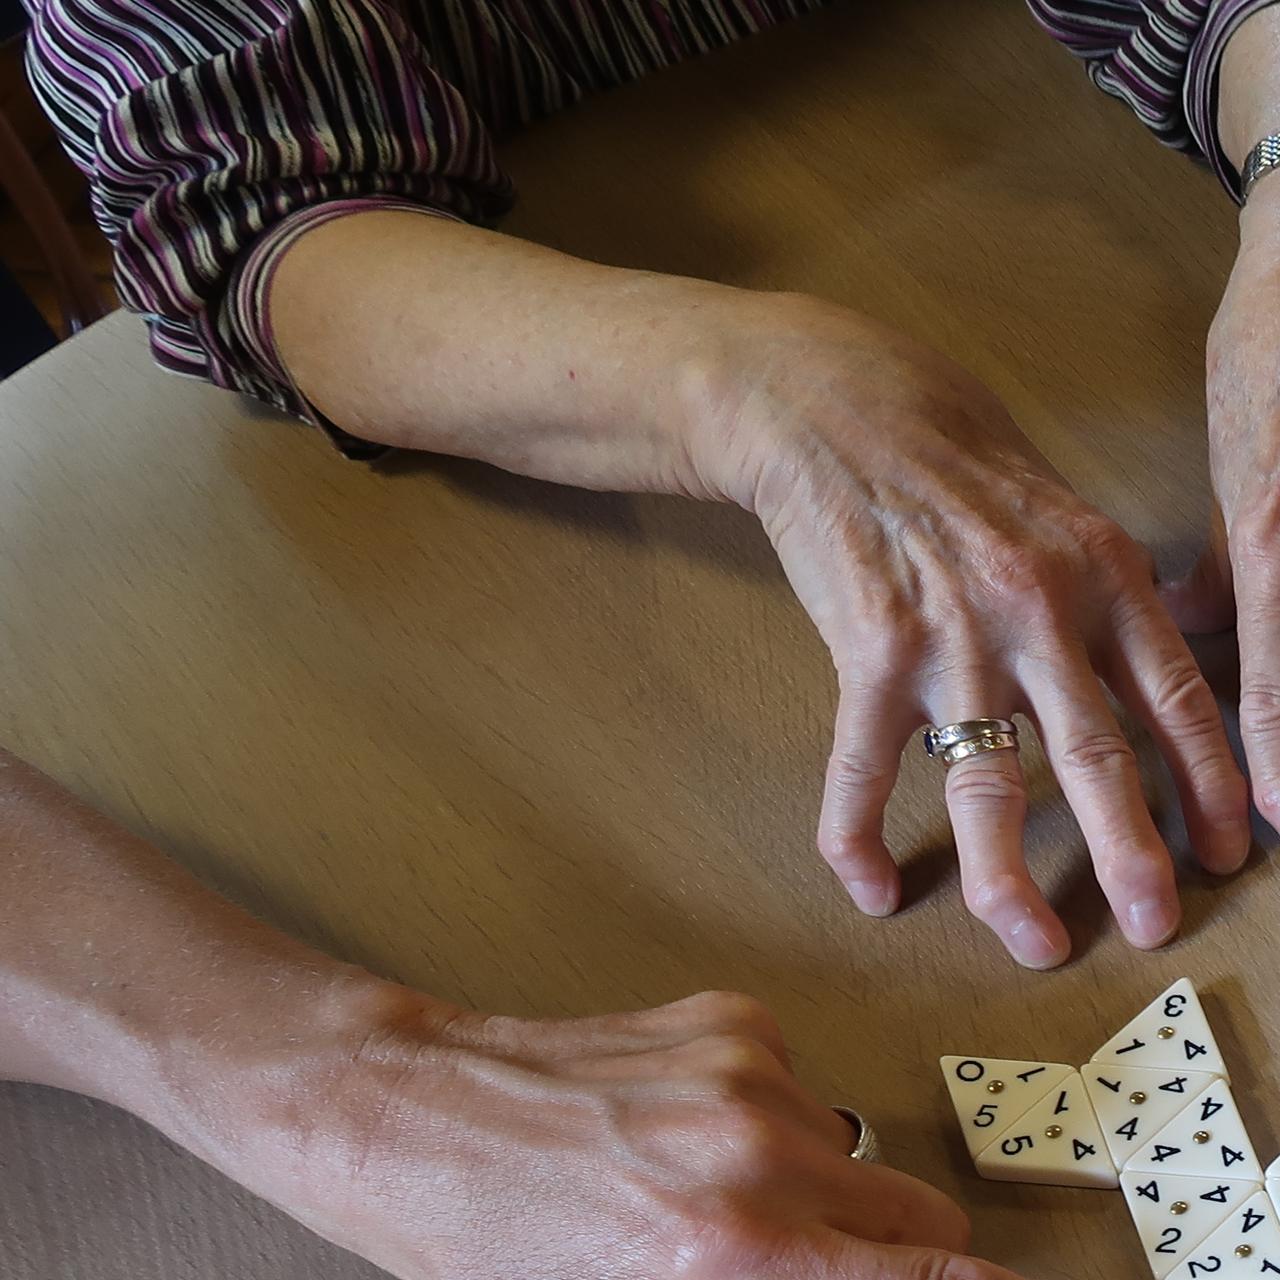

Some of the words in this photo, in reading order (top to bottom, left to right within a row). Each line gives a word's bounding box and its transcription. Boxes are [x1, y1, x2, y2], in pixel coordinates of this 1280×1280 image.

[1163, 994, 1187, 1018] 3
[1183, 1039, 1208, 1061] 4
[955, 1060, 985, 1083] 0
[1157, 1076, 1188, 1094] 4
[973, 1104, 998, 1127] 5
[1200, 1096, 1224, 1122] 4
[1114, 1116, 1139, 1141] 4
[1002, 1135, 1034, 1155] 5
[1072, 1138, 1097, 1161] 4
[1150, 1144, 1182, 1163] 4
[1220, 1144, 1245, 1168] 4
[1135, 1180, 1160, 1203] 4
[1199, 1185, 1231, 1204] 4
[1241, 1207, 1266, 1234] 4
[1154, 1227, 1182, 1254] 2
[1187, 1255, 1222, 1279] 2
